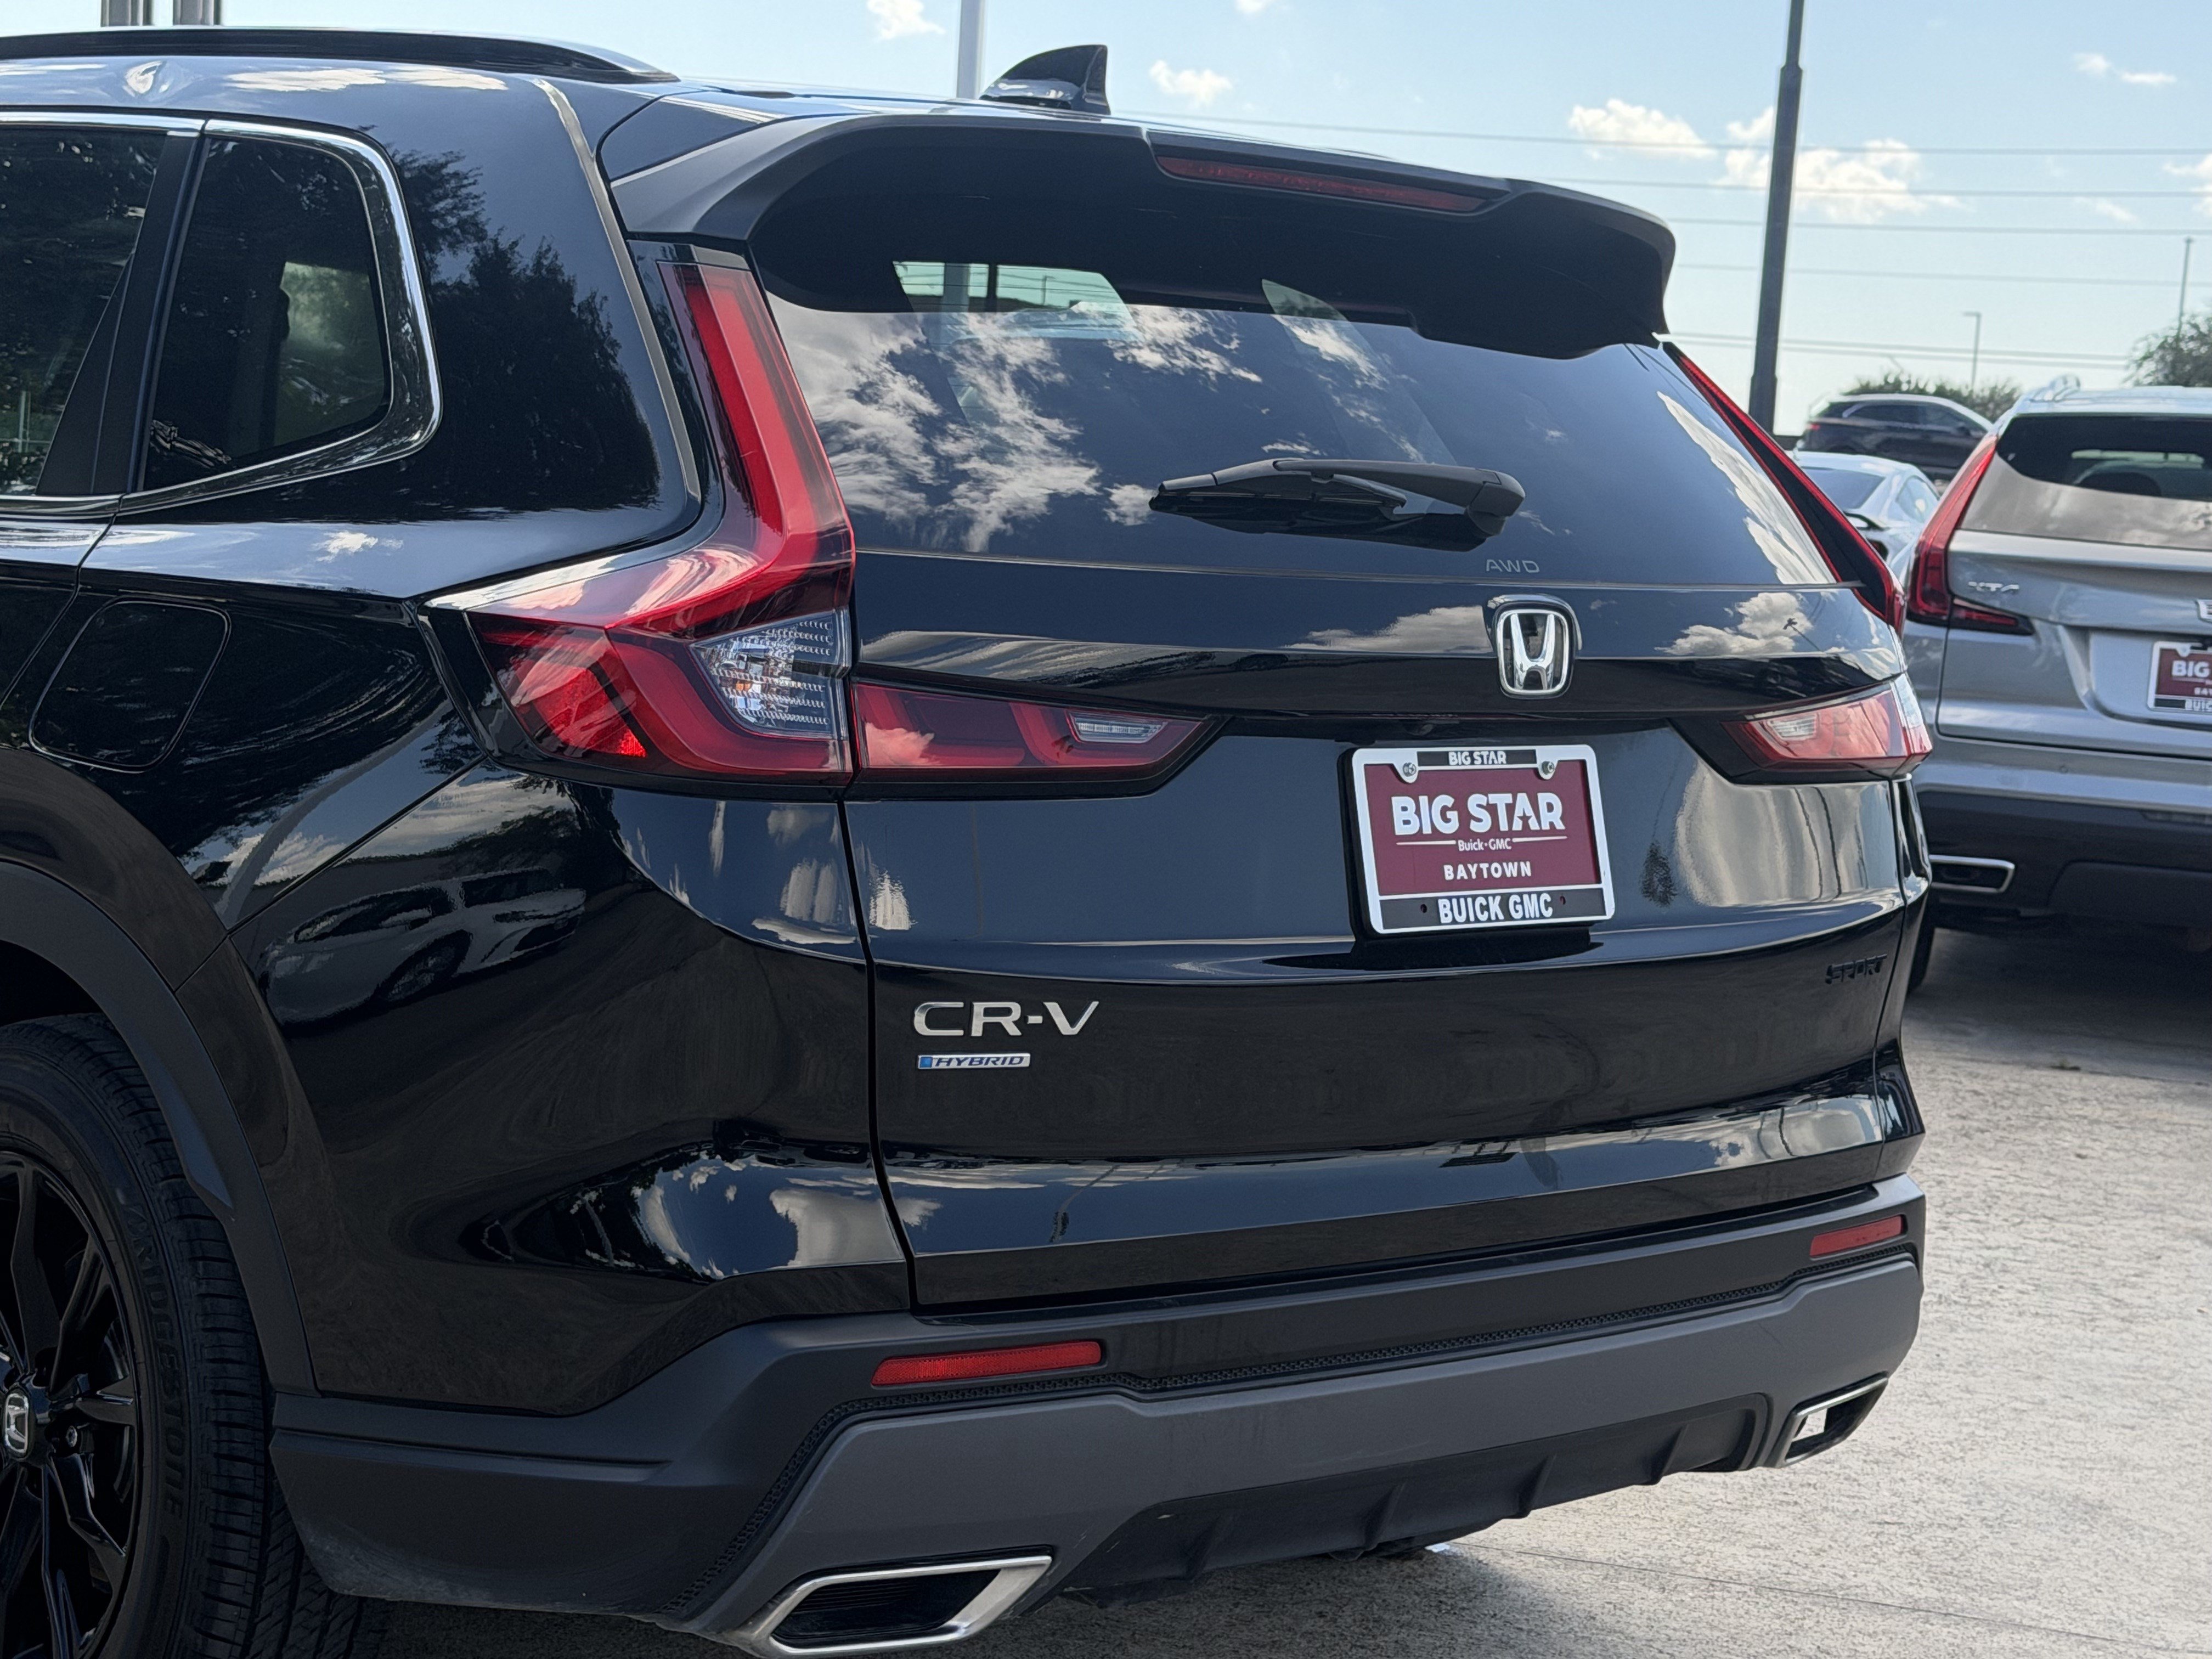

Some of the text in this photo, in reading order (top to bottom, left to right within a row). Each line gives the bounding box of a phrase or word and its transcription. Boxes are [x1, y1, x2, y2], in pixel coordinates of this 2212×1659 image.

[1486, 559, 1540, 573] AWD
[2171, 660, 2210, 678] BIG
[1448, 750, 1507, 766] BIG STAR
[1391, 792, 1566, 836] BIG STAR
[1443, 861, 1532, 881] BAYTOWN
[1437, 893, 1553, 924] BUICK GMC
[1825, 953, 1887, 984] SPORT
[913, 1001, 1099, 1036] CR-V
[935, 1056, 1025, 1067] HYBRID
[122, 1205, 185, 1520] BRIDGESTONE
